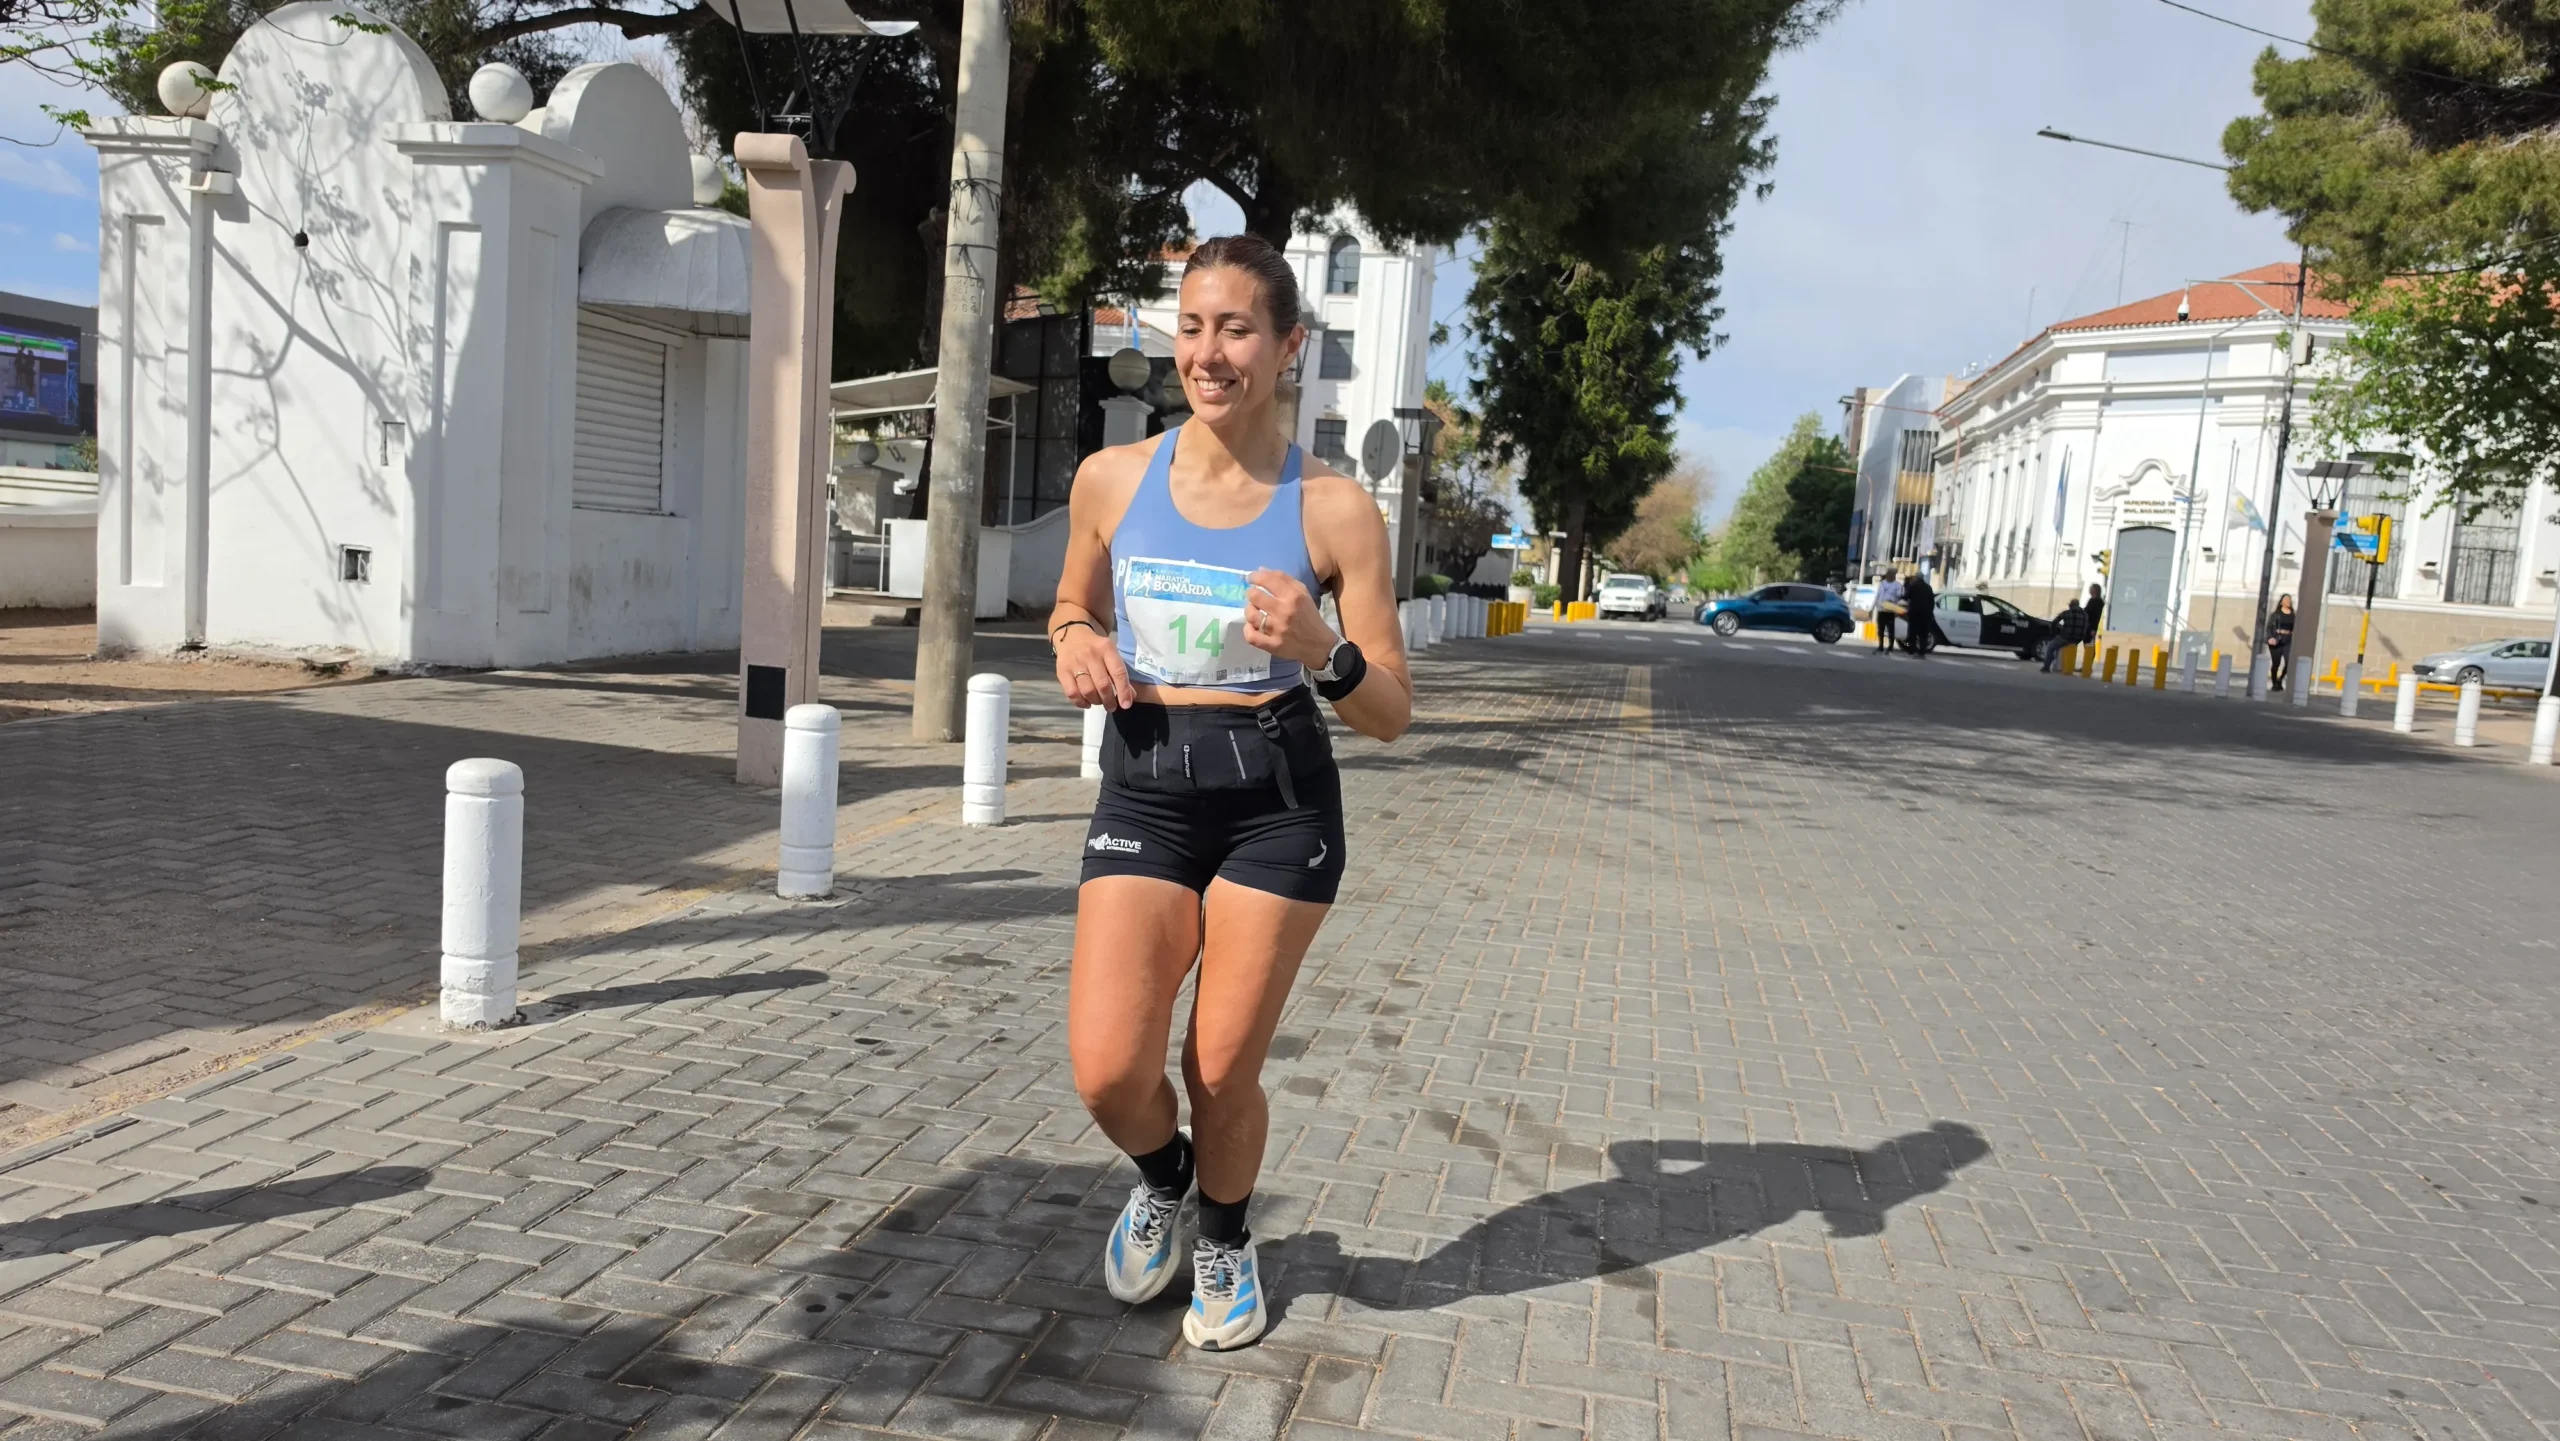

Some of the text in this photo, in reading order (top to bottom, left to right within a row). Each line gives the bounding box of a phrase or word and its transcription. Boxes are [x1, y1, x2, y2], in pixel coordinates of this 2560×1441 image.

[1155, 574, 1191, 584] MARATÓN
[1153, 581, 1213, 596] BONARDA
[1169, 615, 1224, 657] 14
